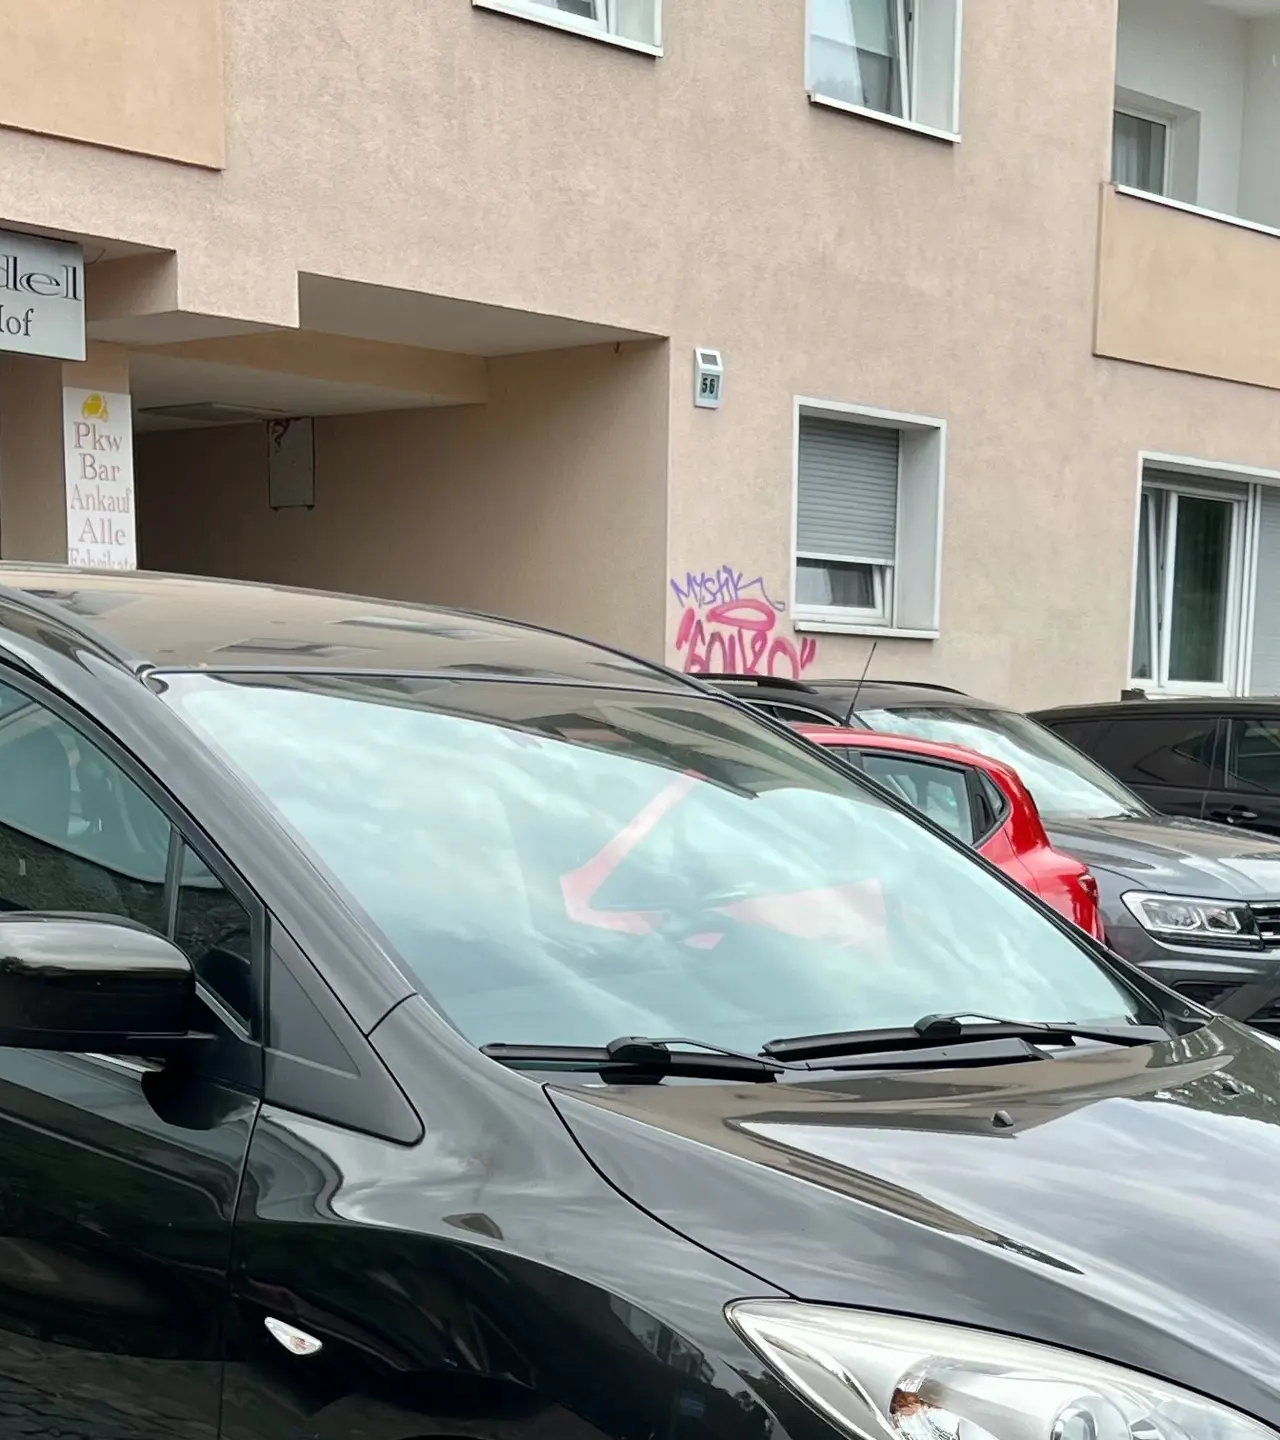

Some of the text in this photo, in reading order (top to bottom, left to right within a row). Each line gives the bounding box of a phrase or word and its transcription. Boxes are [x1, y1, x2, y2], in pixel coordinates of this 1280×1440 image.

[701, 377, 716, 395] 56
[73, 421, 123, 452] Pkw
[80, 452, 121, 482] Bar
[70, 483, 132, 514] Ankauf
[78, 517, 127, 546] Alle
